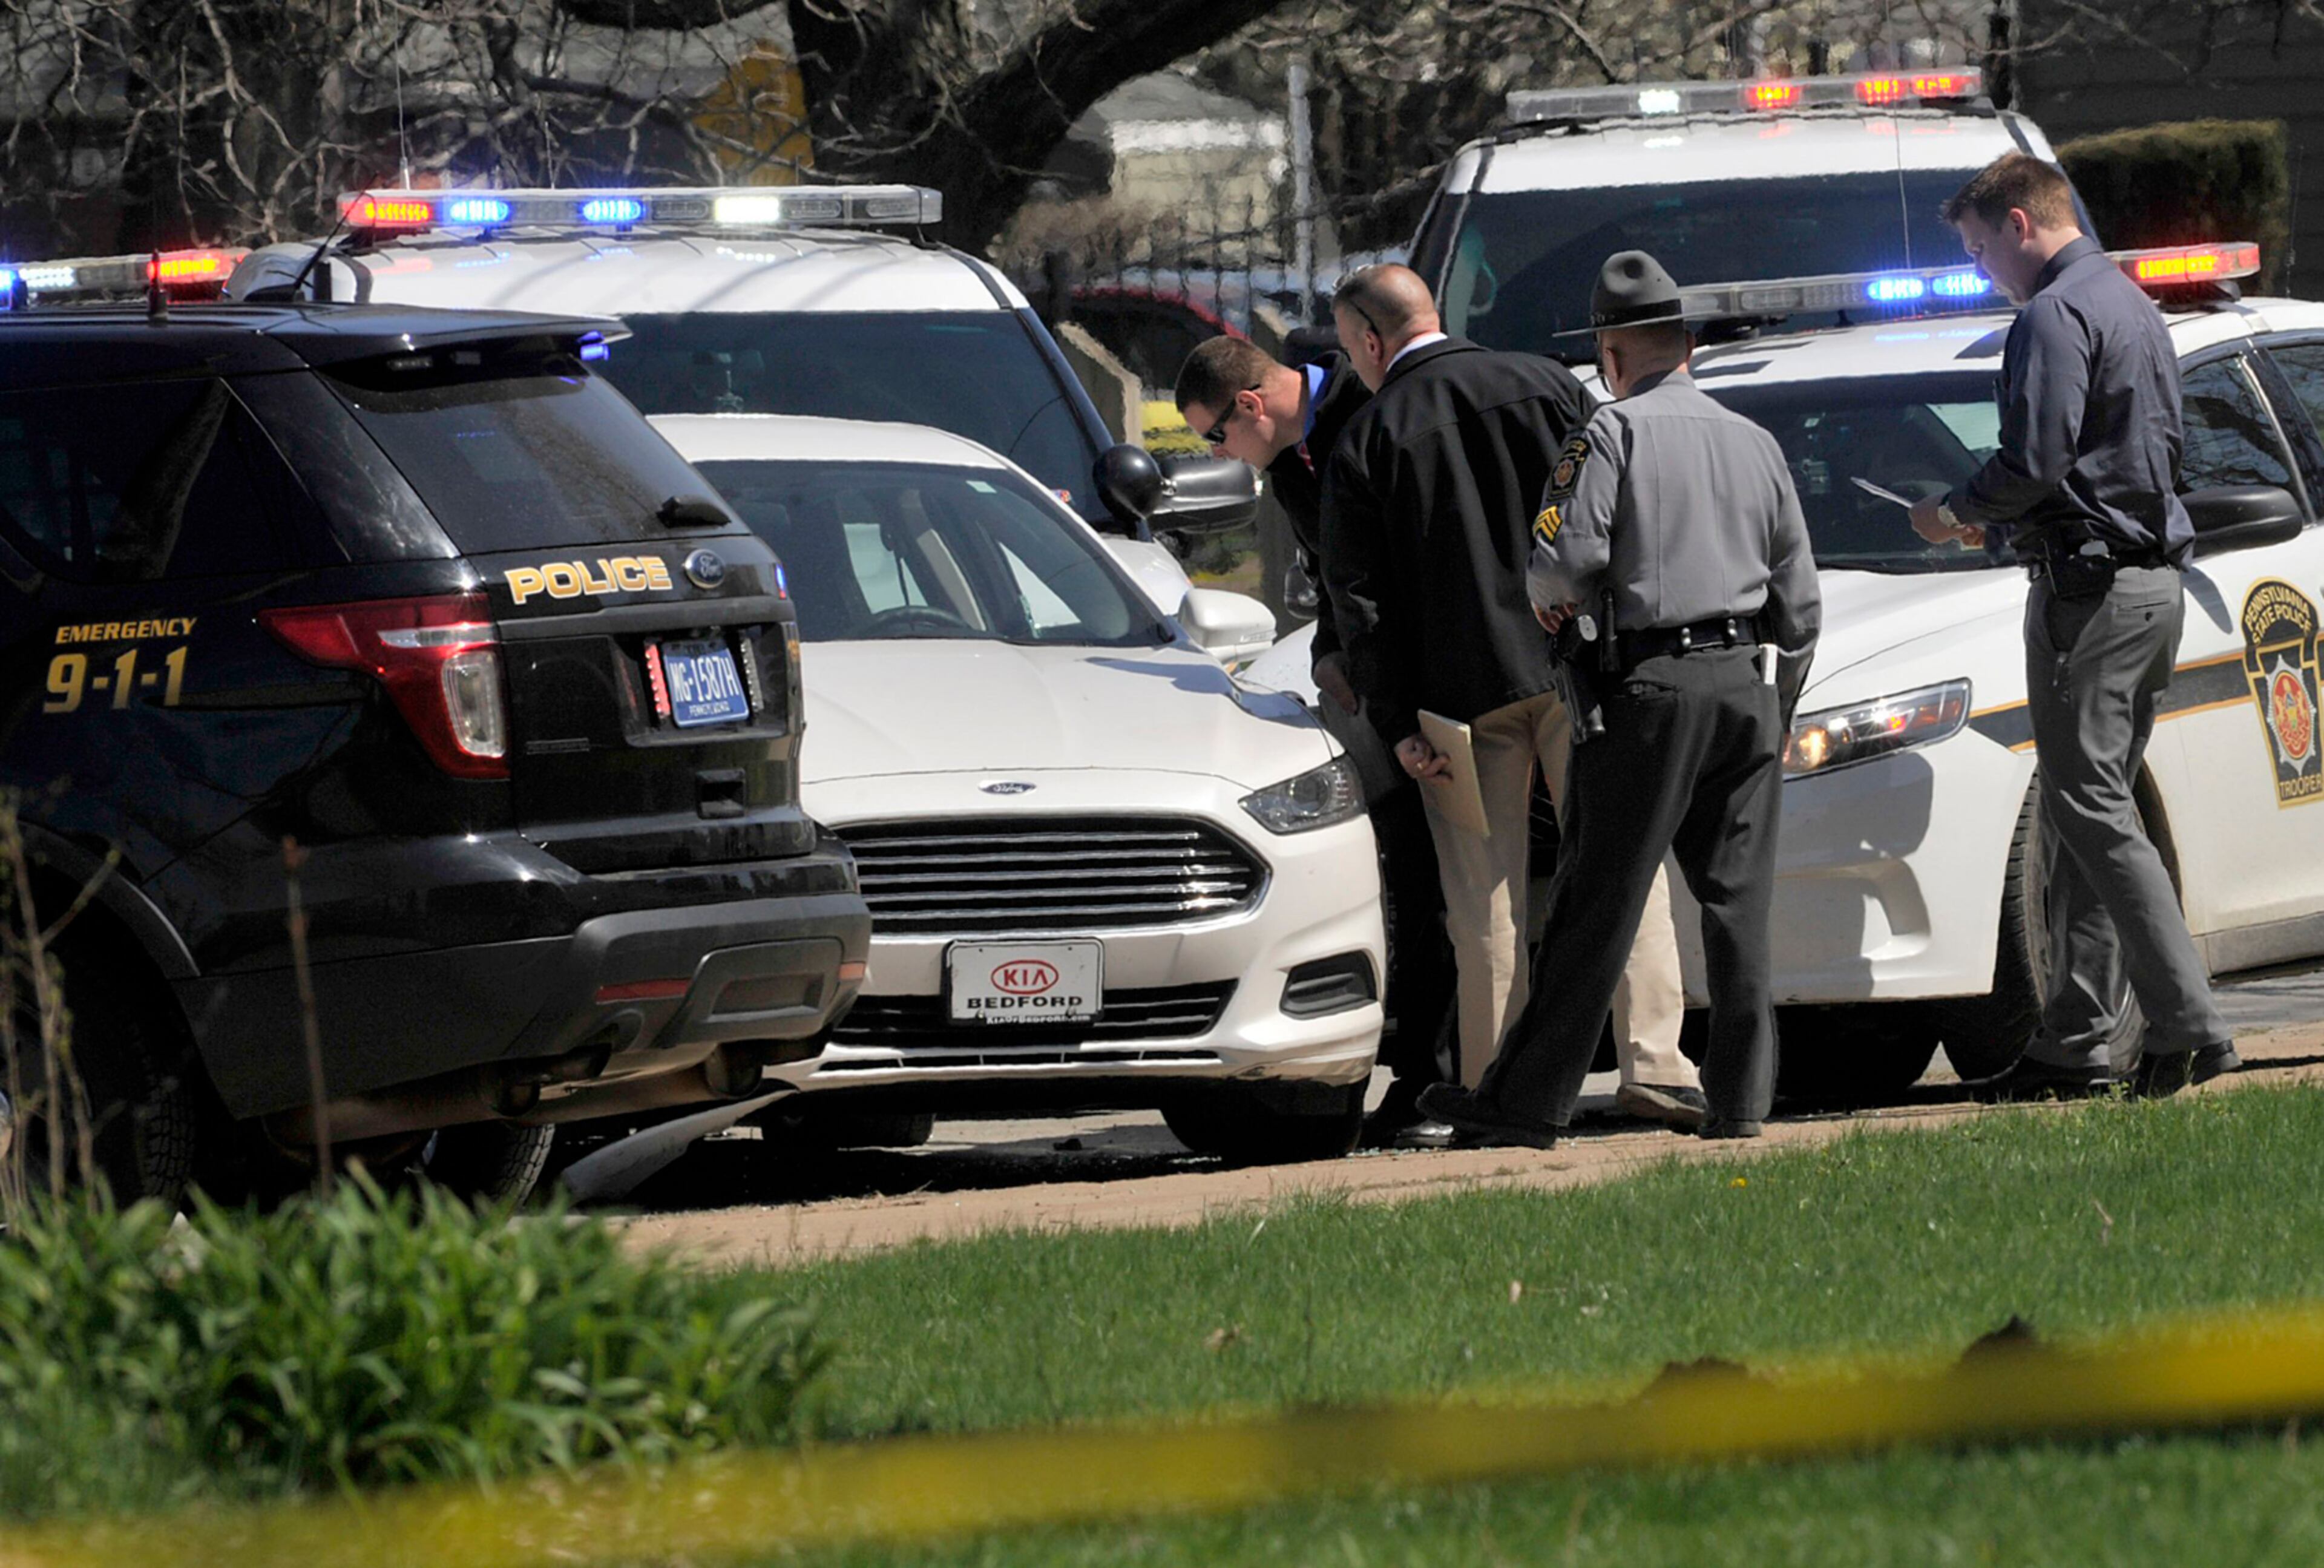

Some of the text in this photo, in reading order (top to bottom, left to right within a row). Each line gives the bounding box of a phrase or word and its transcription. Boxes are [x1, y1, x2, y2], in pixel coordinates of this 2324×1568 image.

[504, 556, 672, 605] POLICE
[2245, 586, 2310, 632] PENNSYLVANIA
[2252, 604, 2311, 645] STATE POLICE
[56, 618, 196, 644] EMERGENCY
[43, 646, 187, 713] 9-1-1
[2279, 773, 2322, 798] TROOPER
[1003, 969, 1049, 986] KIA
[967, 996, 1083, 1009] BEDFORD
